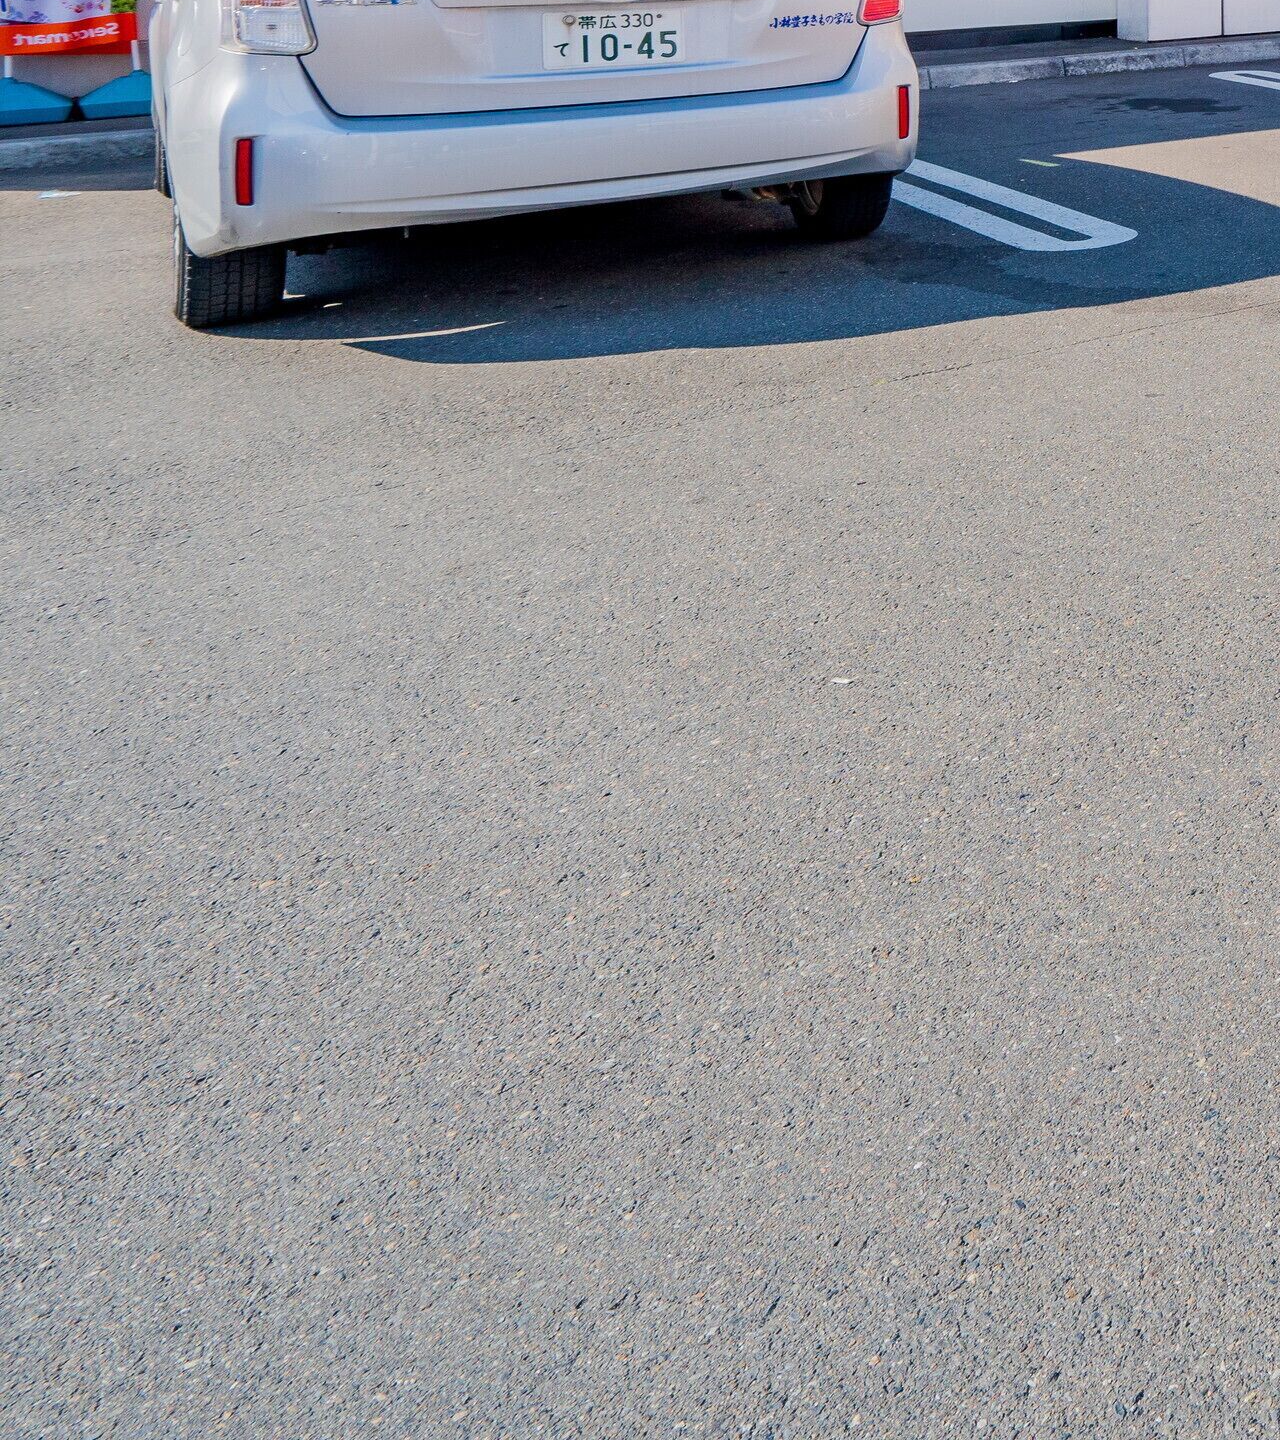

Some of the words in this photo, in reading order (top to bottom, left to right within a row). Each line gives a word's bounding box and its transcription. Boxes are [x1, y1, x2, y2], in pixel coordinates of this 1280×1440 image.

[620, 12, 653, 29] 330
[554, 42, 569, 58] て
[583, 30, 677, 63] 10-45
